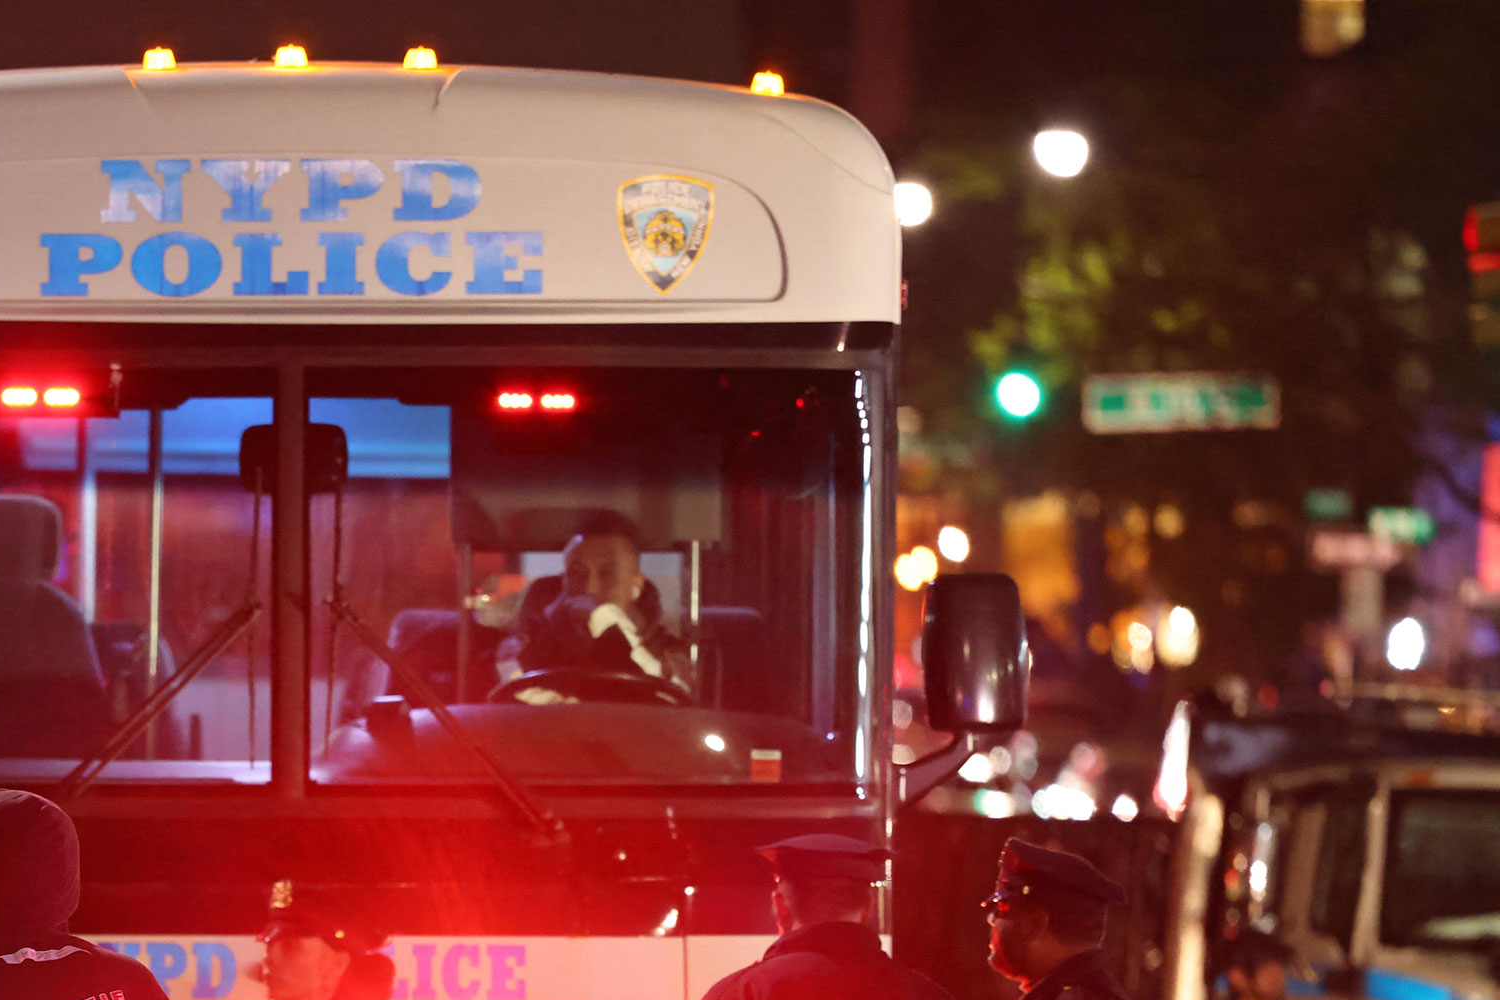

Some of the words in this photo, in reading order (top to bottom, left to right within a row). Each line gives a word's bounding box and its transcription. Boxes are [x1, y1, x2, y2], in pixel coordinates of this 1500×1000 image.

[100, 158, 483, 222] NYPD
[40, 231, 543, 297] POLICE
[98, 942, 237, 999] PD
